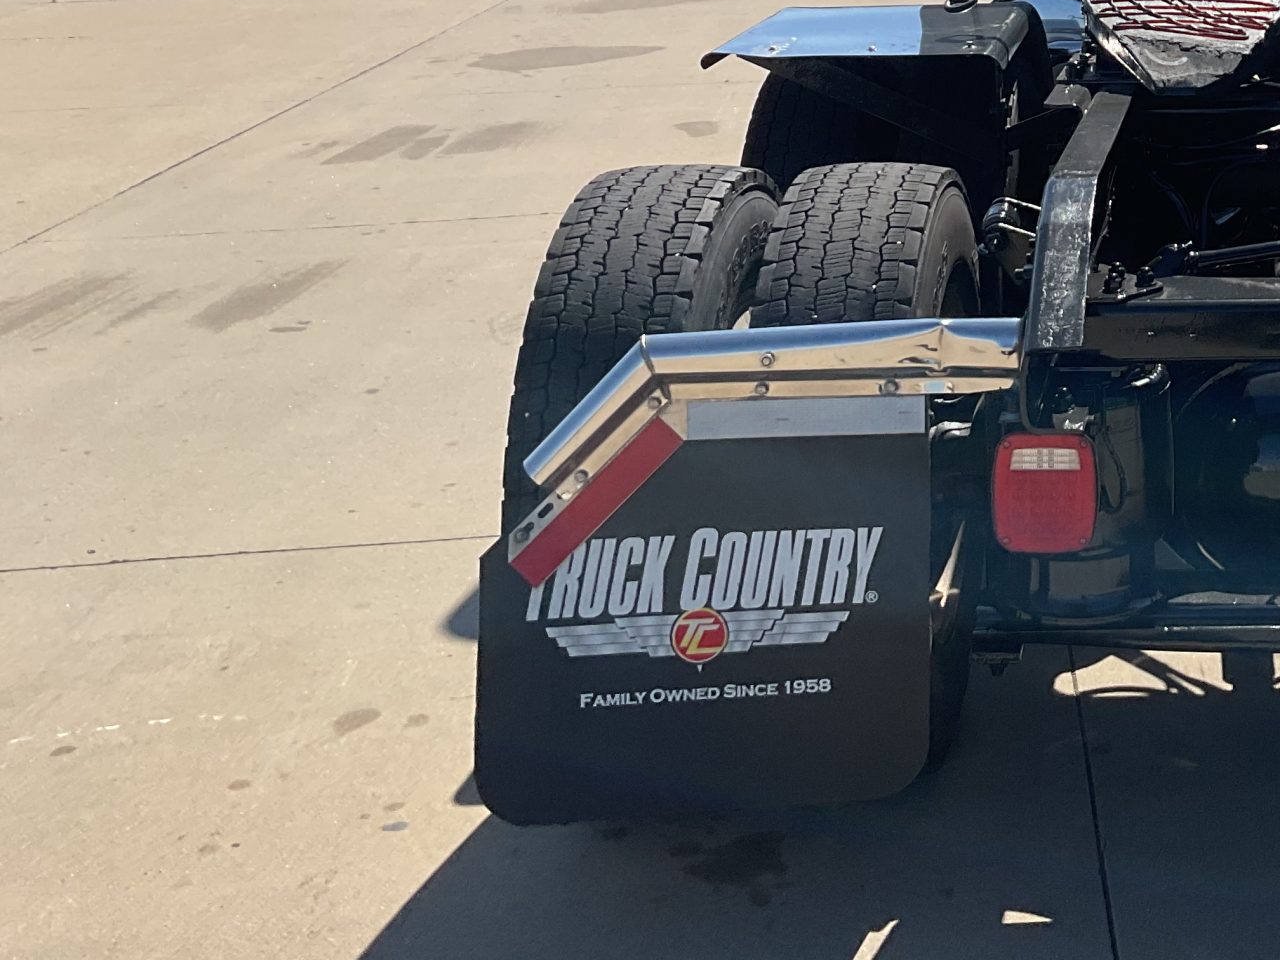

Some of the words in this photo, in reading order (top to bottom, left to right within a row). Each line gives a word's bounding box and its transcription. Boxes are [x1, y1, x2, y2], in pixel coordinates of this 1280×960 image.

[580, 691, 647, 708] FAMILY
[650, 687, 720, 703] OWNED
[723, 683, 778, 698] SINCE
[784, 678, 832, 694] 1958
